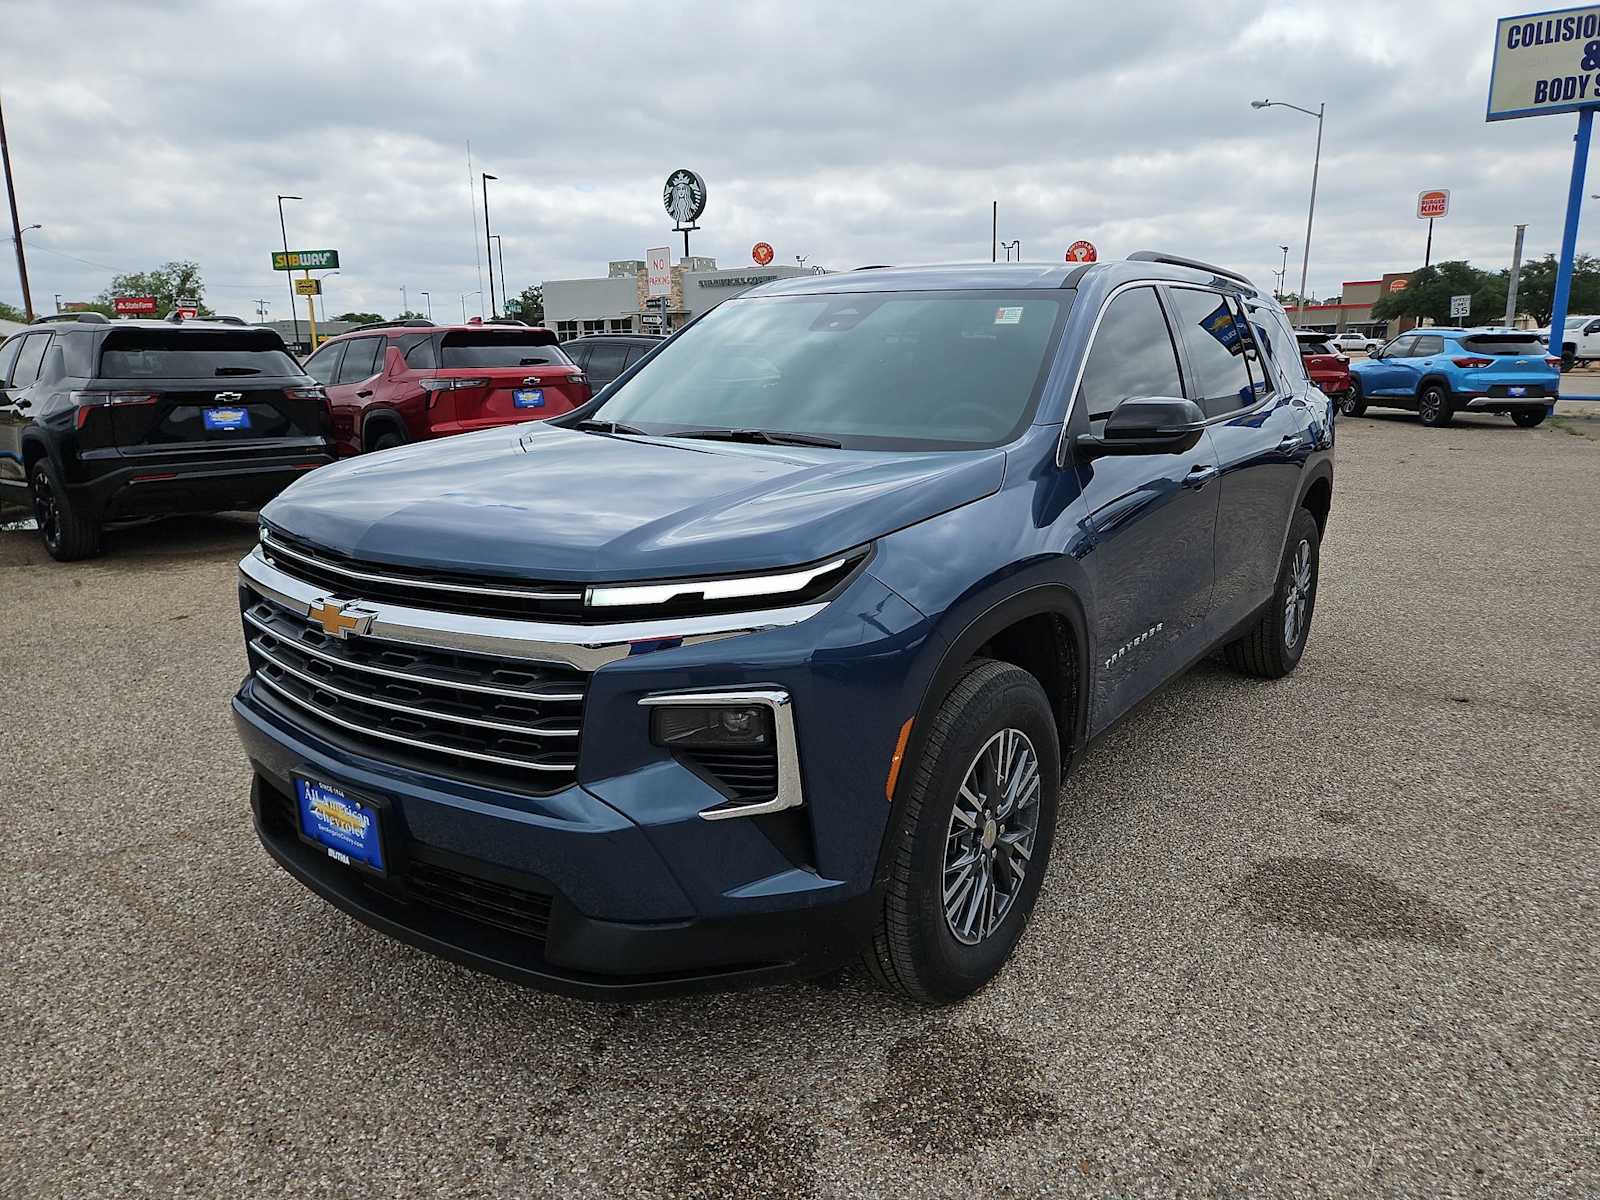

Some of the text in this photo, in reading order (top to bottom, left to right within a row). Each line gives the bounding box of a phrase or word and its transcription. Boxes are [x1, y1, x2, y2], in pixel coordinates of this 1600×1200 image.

[1507, 14, 1600, 49] COLLISIO
[1581, 40, 1600, 71] &
[1534, 74, 1591, 104] BODY
[1421, 204, 1445, 212] KING
[275, 253, 327, 266] SUBWAY
[653, 259, 664, 270] NO
[648, 275, 670, 286] PARKING
[1454, 306, 1468, 314] 35
[1105, 622, 1164, 669] TRAVERSE
[304, 788, 370, 828] All American
[310, 806, 368, 839] Chevrolet
